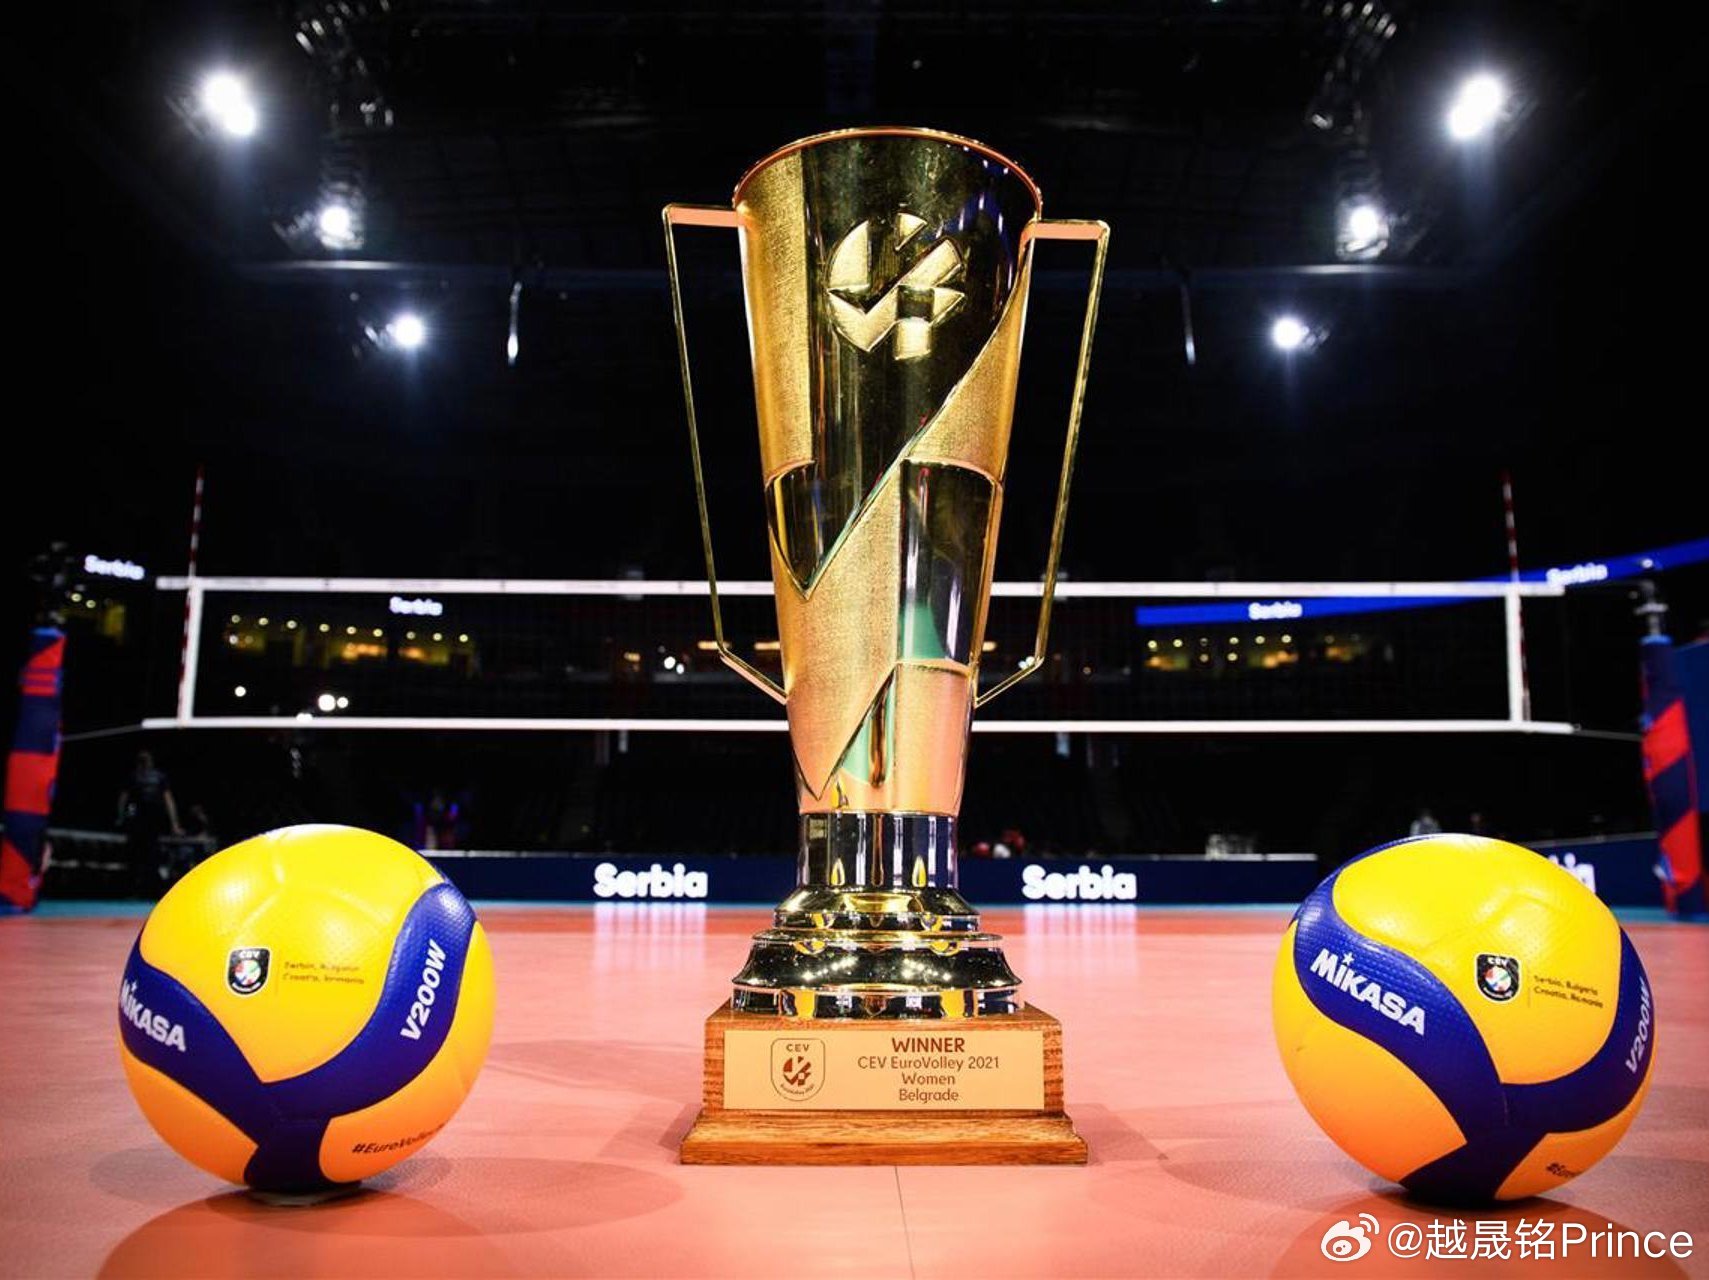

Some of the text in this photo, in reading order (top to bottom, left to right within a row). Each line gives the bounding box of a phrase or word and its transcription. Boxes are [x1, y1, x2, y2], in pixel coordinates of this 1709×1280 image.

[593, 862, 708, 898] Serbia
[1022, 864, 1137, 900] Serbia
[400, 938, 446, 1040] V200W
[786, 1043, 810, 1053] CEV
[891, 1037, 966, 1053] WINNER
[857, 1056, 1000, 1072] CEV EuroVolley 2021
[901, 1072, 956, 1085] Women
[898, 1088, 959, 1104] Belgrade
